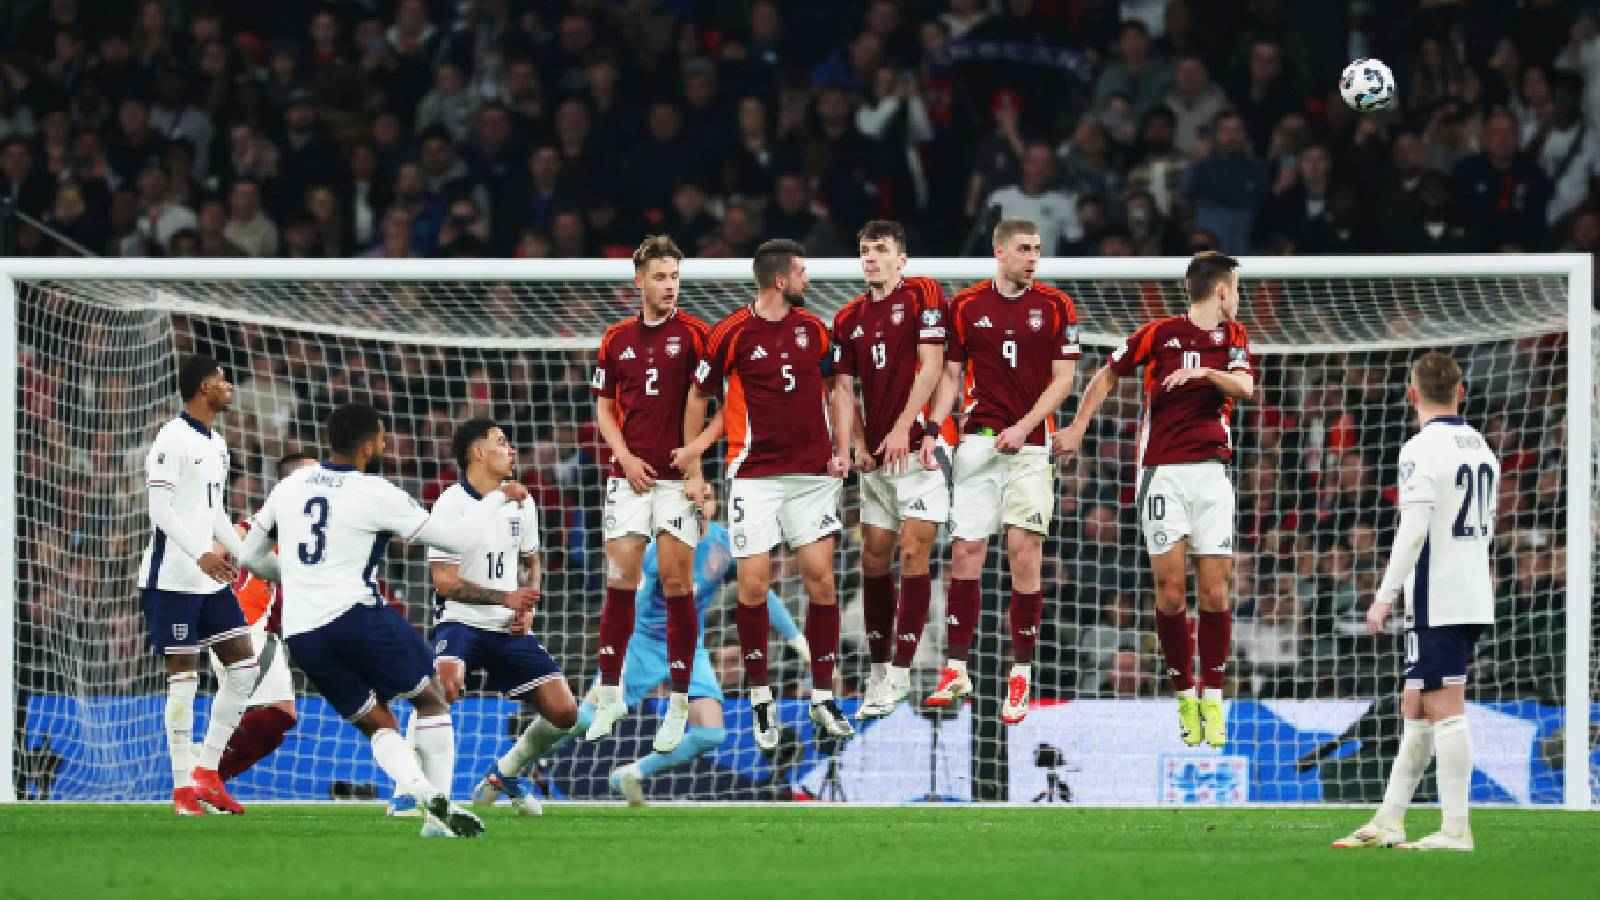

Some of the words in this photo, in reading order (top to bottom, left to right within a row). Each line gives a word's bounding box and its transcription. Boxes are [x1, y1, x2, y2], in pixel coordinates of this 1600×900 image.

[1002, 341, 1017, 368] 9
[645, 368, 659, 396] 2
[782, 364, 796, 392] 5
[733, 497, 745, 523] 5
[1149, 494, 1166, 521] 10
[1452, 463, 1495, 536] 20
[298, 496, 328, 564] 3
[486, 551, 504, 580] 16
